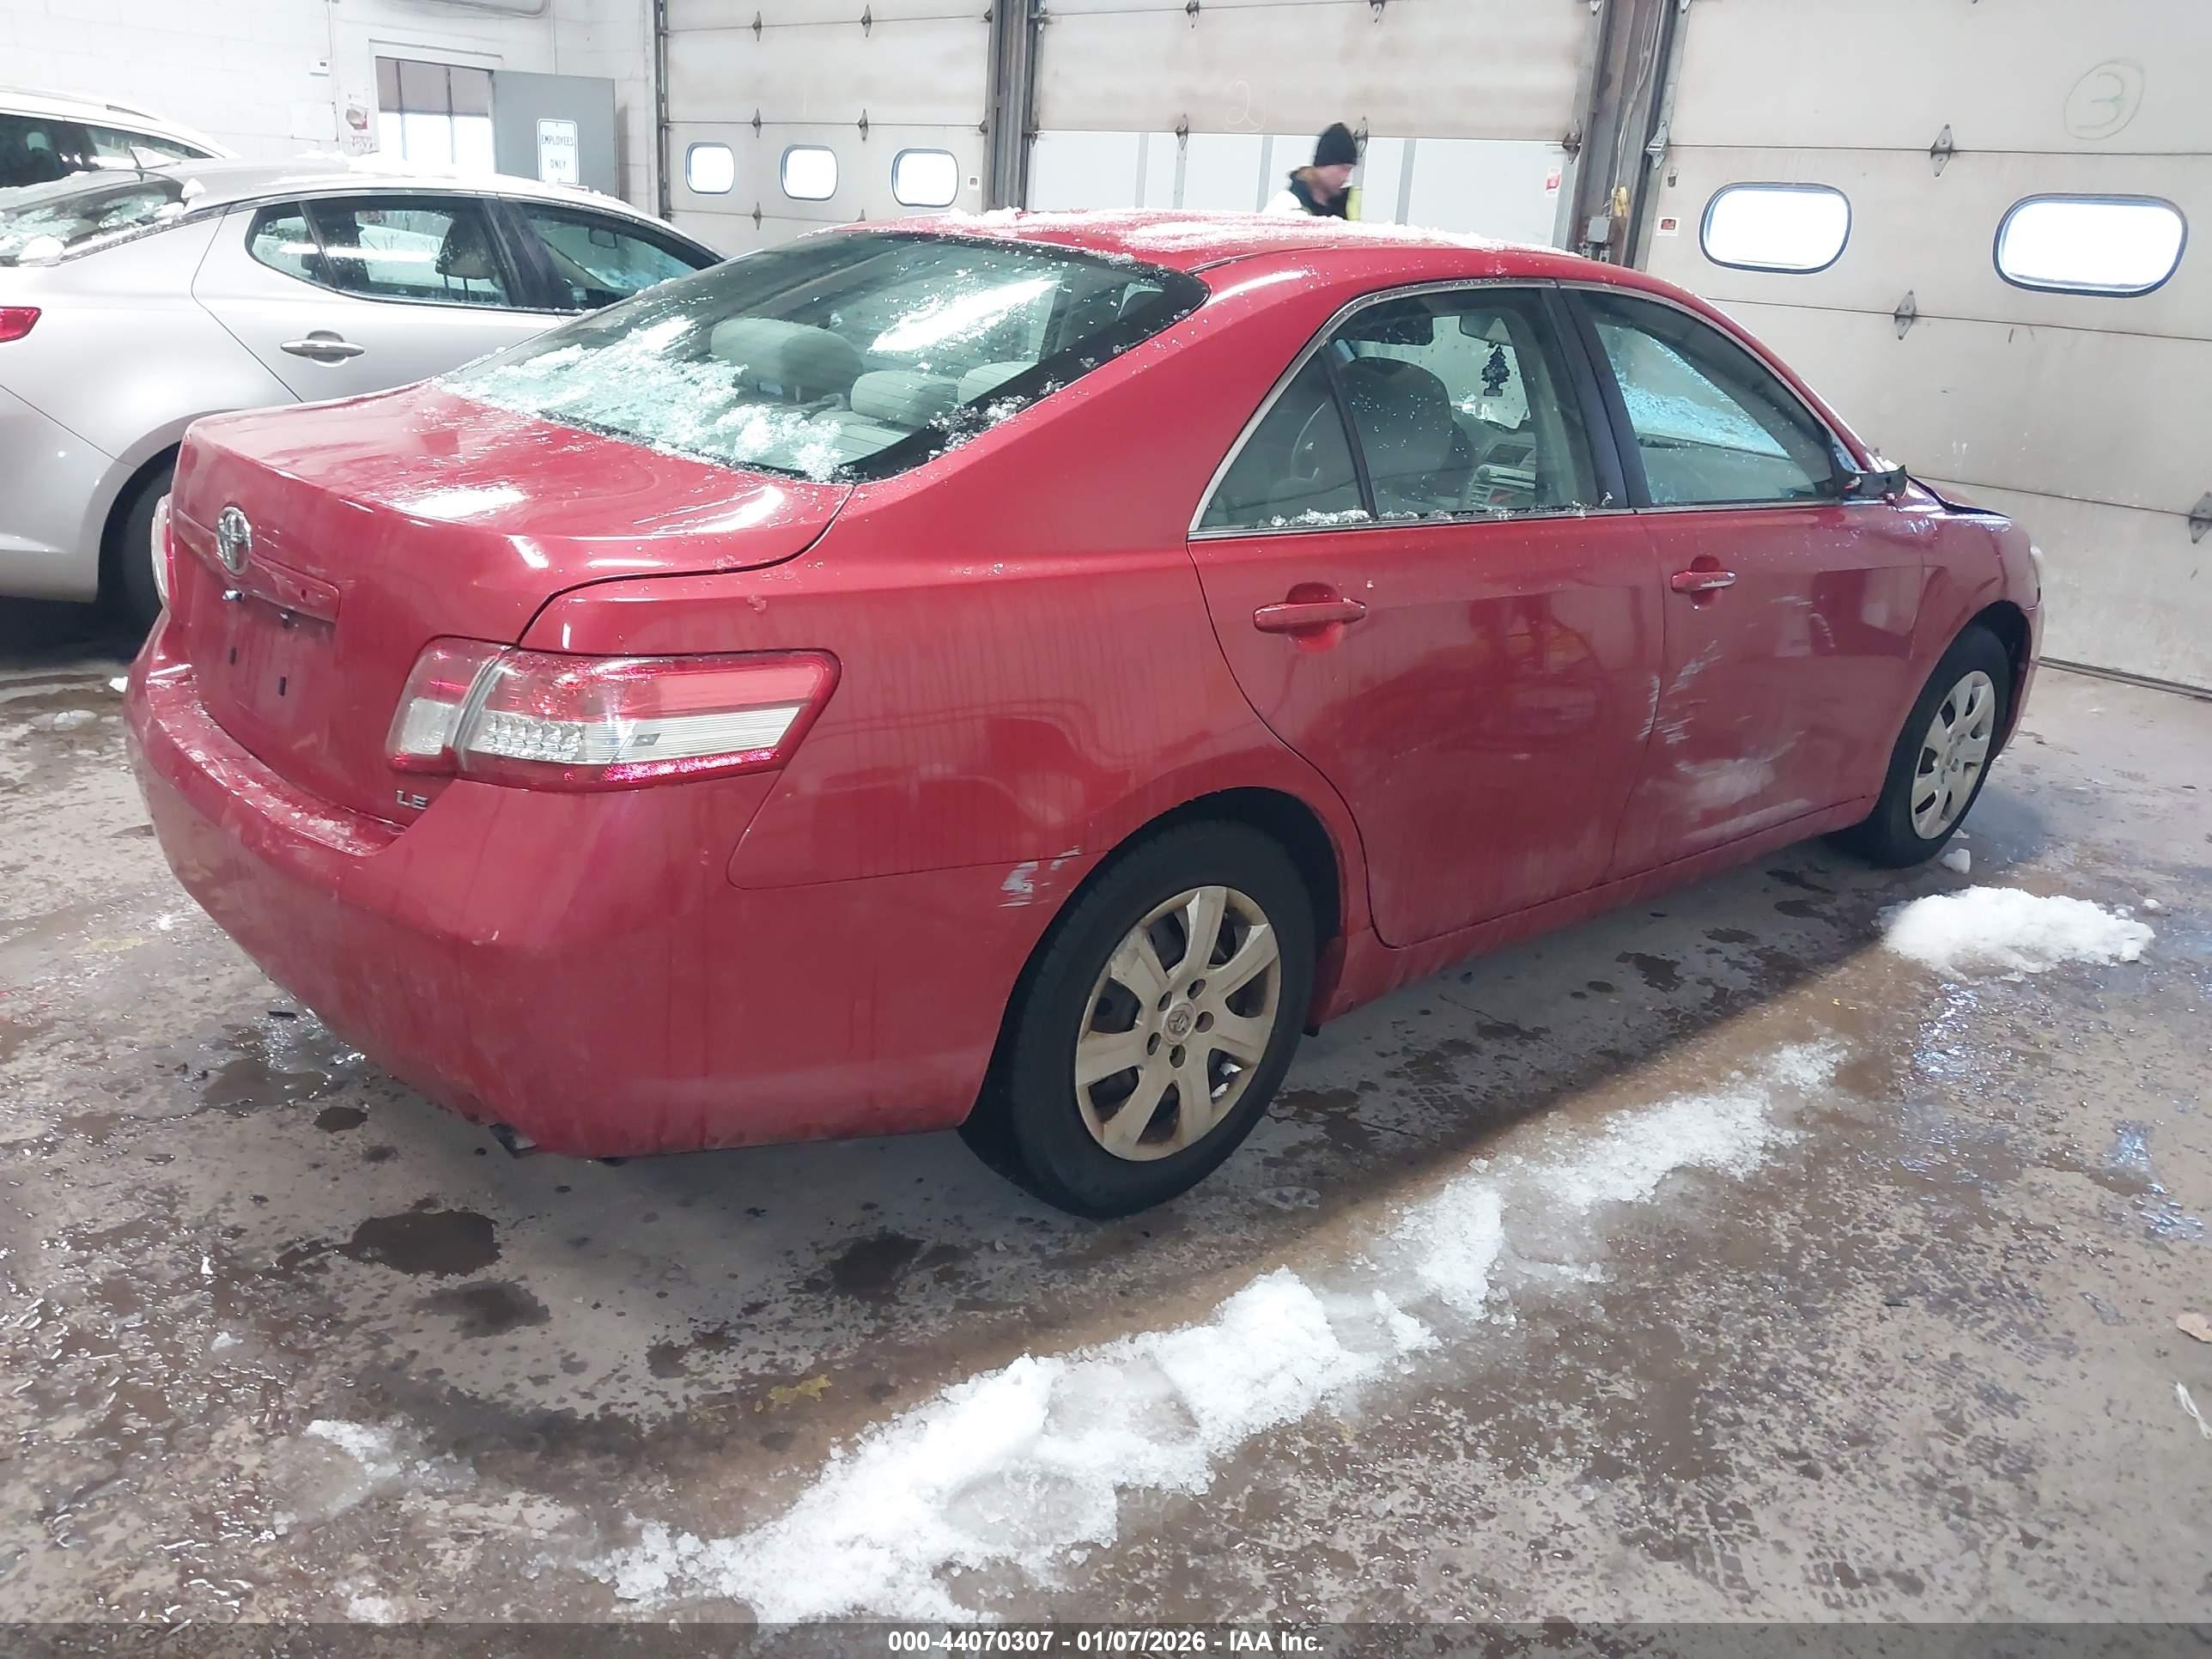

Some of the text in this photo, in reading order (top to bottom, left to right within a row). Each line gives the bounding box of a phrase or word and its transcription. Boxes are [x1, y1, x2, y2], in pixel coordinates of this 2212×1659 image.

[2075, 72, 2124, 129] 3
[541, 134, 574, 147] EMPLOYEES
[550, 158, 567, 170] ONLY
[396, 789, 429, 810] LE
